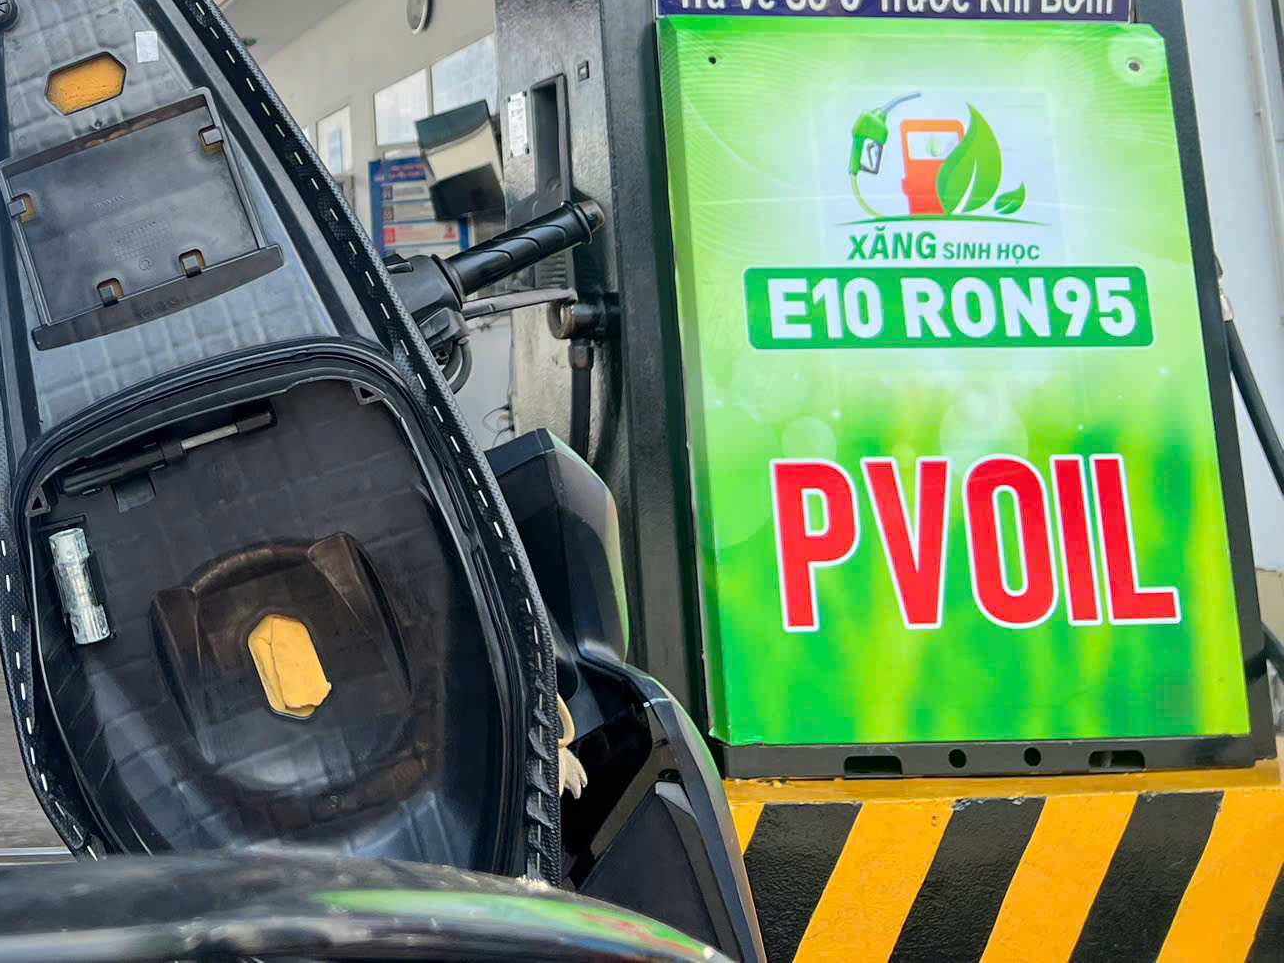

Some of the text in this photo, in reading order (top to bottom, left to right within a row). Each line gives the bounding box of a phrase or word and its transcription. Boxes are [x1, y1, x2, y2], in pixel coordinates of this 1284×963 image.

[846, 225, 1040, 264] XĂNG SINH HỌC
[767, 275, 1136, 340] E10 RON95
[770, 453, 1181, 633] PVOIL
